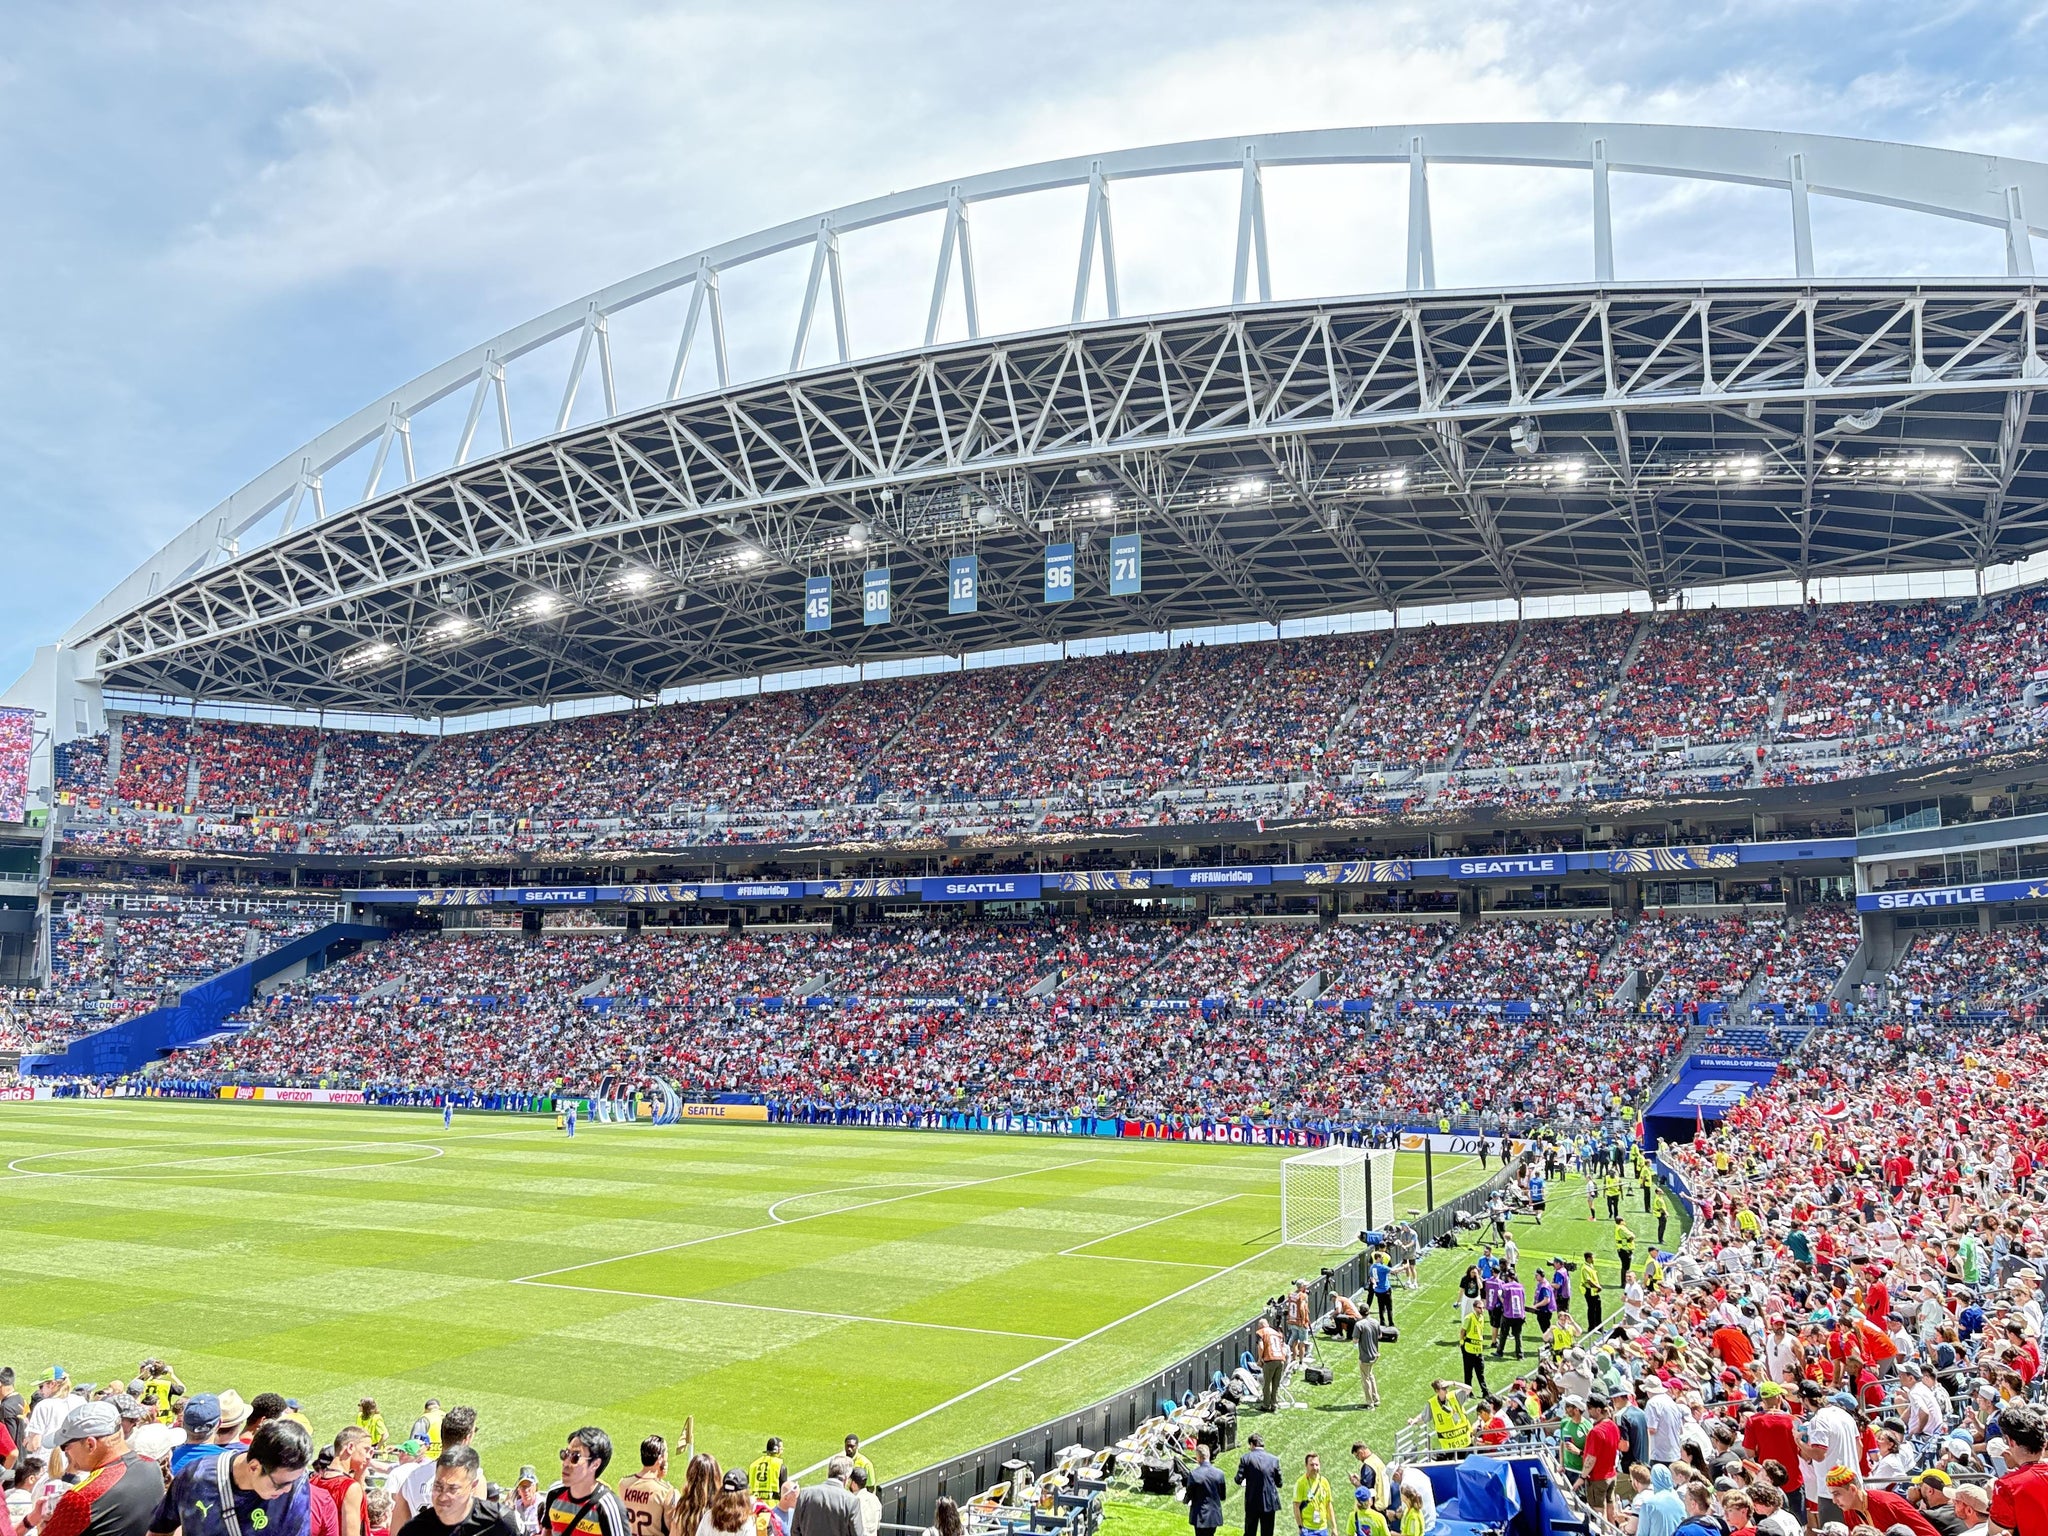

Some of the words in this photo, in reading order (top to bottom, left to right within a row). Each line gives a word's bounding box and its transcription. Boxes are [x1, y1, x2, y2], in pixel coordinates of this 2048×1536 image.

[1047, 565, 1072, 589] 96
[1114, 557, 1137, 581] 71
[953, 577, 973, 600] 12
[806, 597, 829, 619] 45
[866, 589, 888, 612] 80
[1460, 859, 1554, 875] SEATTLE
[1189, 870, 1254, 884] #FIFAWorldCup
[525, 891, 587, 901] SEATTLE
[737, 885, 789, 897] #FIFAWorldCup
[945, 882, 1015, 894] SEATTLE
[1878, 887, 1986, 909] SEATTLE
[276, 1088, 313, 1102] verizon
[687, 1105, 725, 1117] SEATTLE
[1450, 1134, 1495, 1153] Doe
